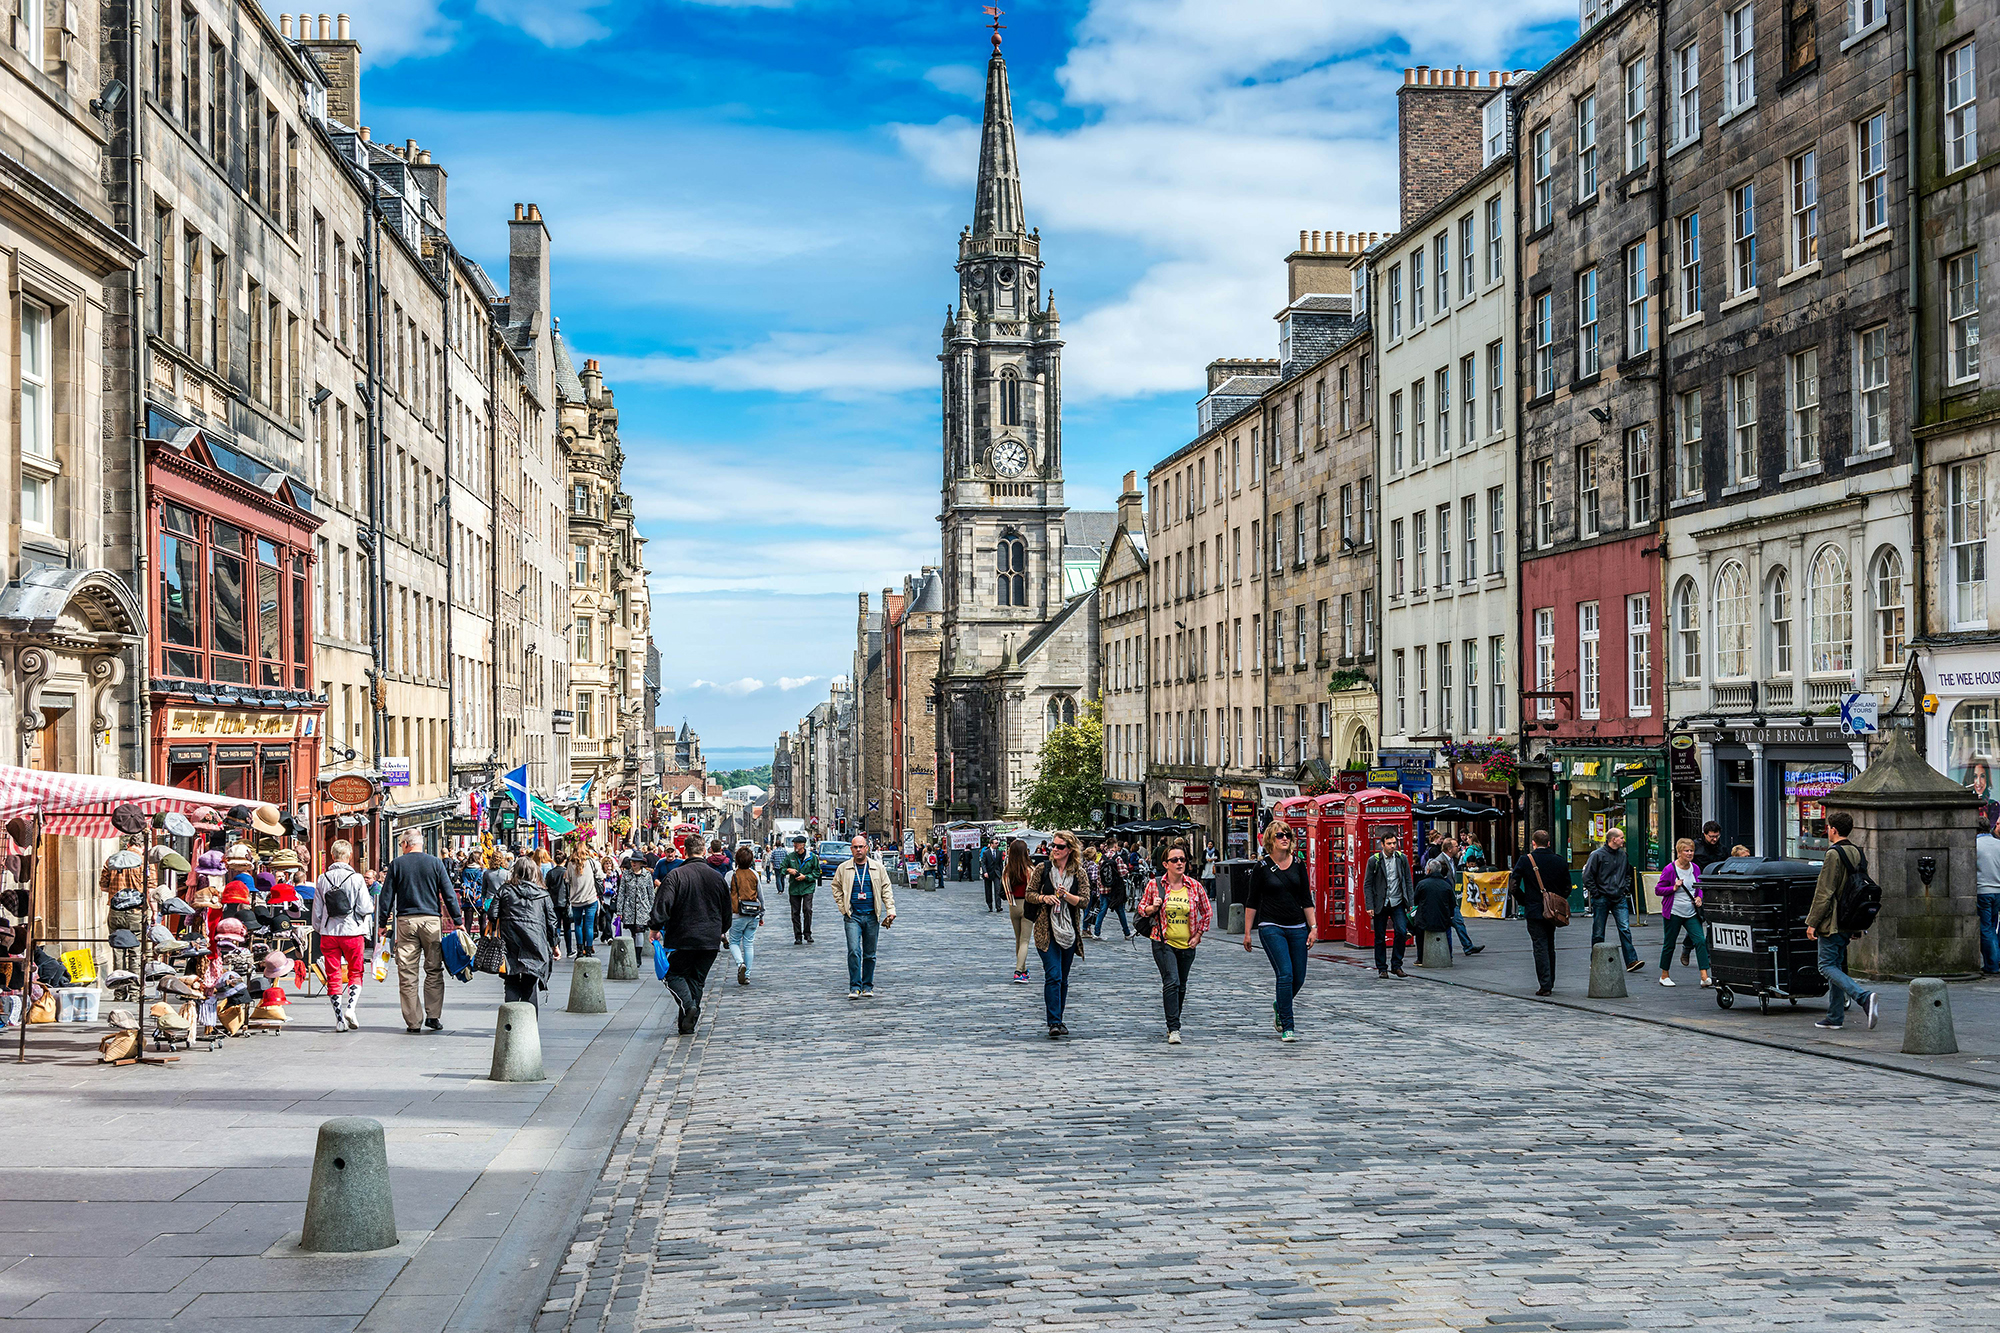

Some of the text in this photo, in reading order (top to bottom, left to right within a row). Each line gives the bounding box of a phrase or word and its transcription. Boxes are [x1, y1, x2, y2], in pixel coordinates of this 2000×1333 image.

[1938, 671, 2000, 686] THE WEE HOUS
[190, 716, 210, 734] THE
[1735, 729, 1751, 742] BAY
[1757, 729, 1770, 742] OF
[1776, 729, 1820, 742] BENGAL
[1572, 760, 1600, 776] SUBWAY
[1785, 771, 1800, 782] BAY
[1803, 772, 1816, 784] OF
[1621, 776, 1648, 798] SUBWAY
[1715, 927, 1749, 947] LITTER
